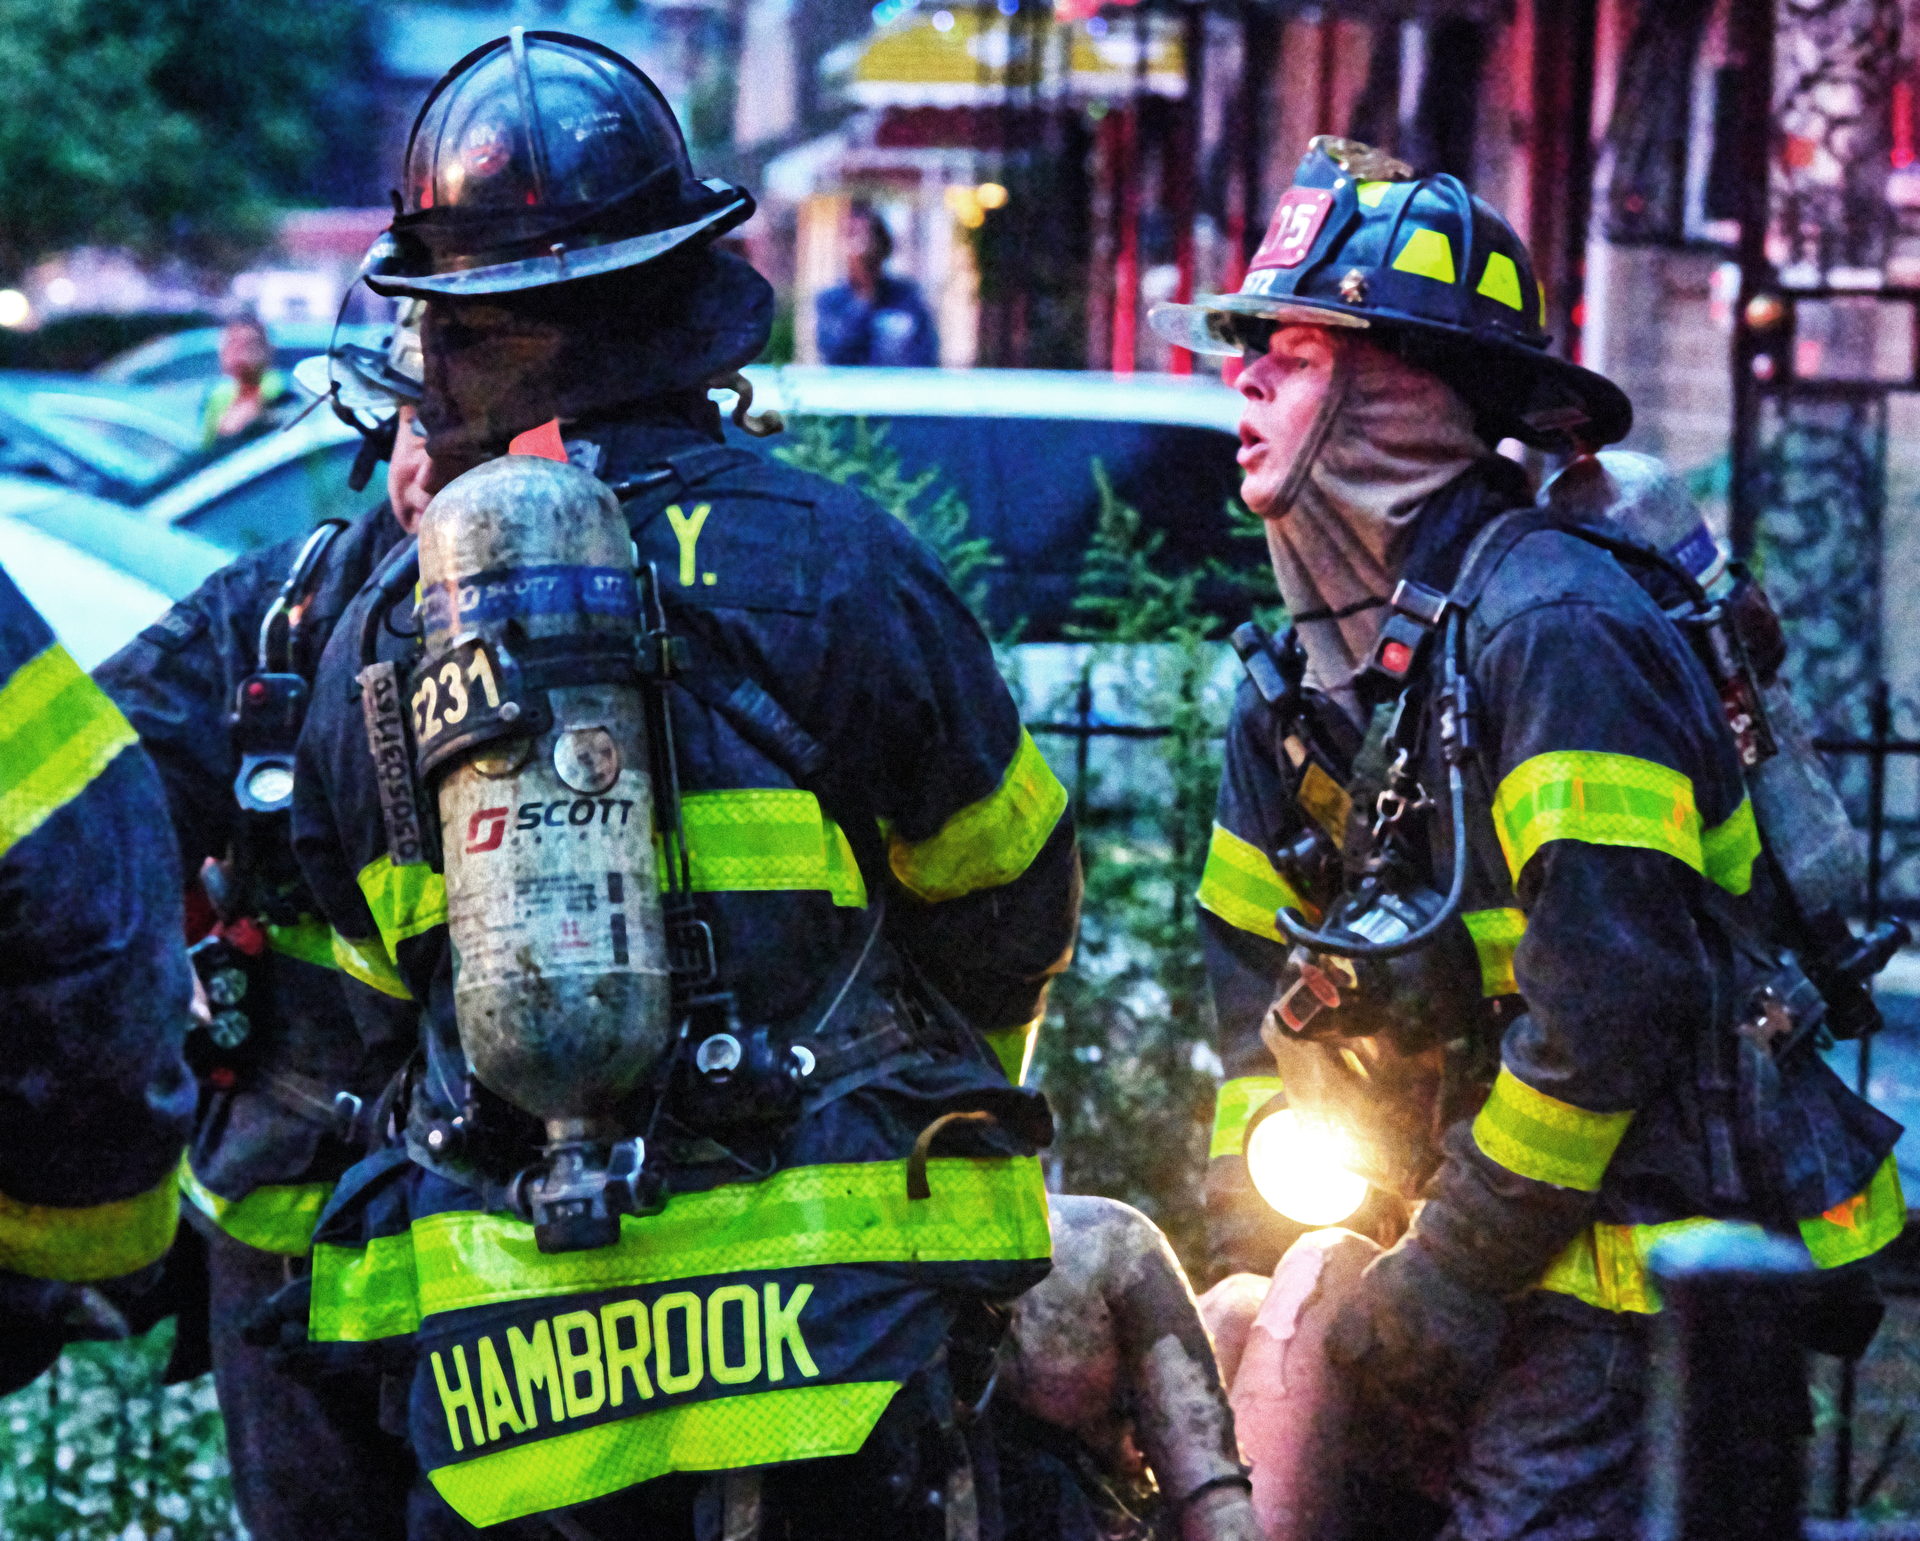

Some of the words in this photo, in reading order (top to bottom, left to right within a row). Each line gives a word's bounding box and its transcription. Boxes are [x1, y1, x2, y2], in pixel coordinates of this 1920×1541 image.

[665, 502, 718, 587] Y.
[516, 798, 634, 831] SCOTT
[430, 1281, 820, 1452] HAMBROOK
